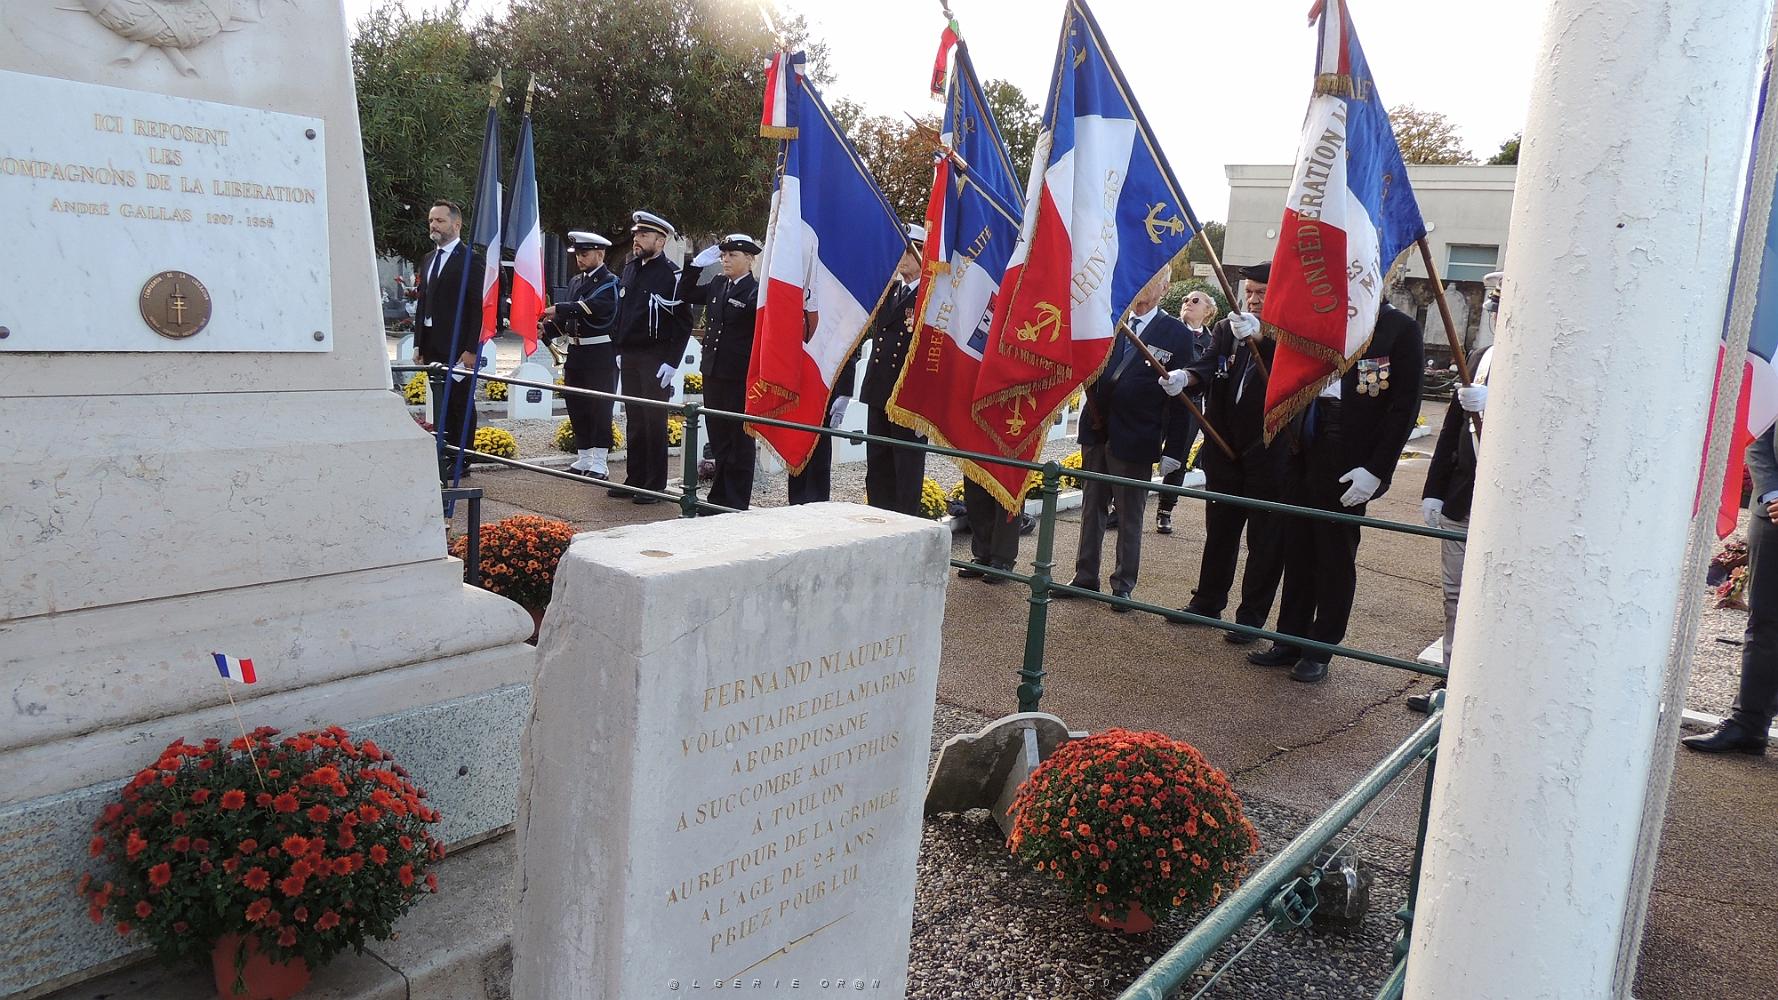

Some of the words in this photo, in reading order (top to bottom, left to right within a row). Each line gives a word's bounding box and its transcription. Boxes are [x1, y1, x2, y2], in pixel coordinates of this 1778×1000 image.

[94, 113, 123, 134] ICI
[133, 118, 229, 147] REPOSENT
[0, 157, 137, 188] OMPAGNONS
[147, 173, 171, 191] DE
[180, 176, 205, 194] LA
[148, 147, 183, 167] LES
[119, 203, 193, 223] GALLAS
[703, 660, 812, 713] FERNAND
[818, 633, 908, 679] NIAUDET
[772, 783, 845, 827] TOULON
[784, 827, 809, 853] DE
[813, 819, 834, 841] LA
[782, 859, 806, 885] DE
[813, 846, 836, 869] 24
[843, 826, 876, 857] ANS
[710, 906, 773, 955] PRIEZ
[779, 880, 826, 917] POUR
[831, 863, 858, 892] LUI
